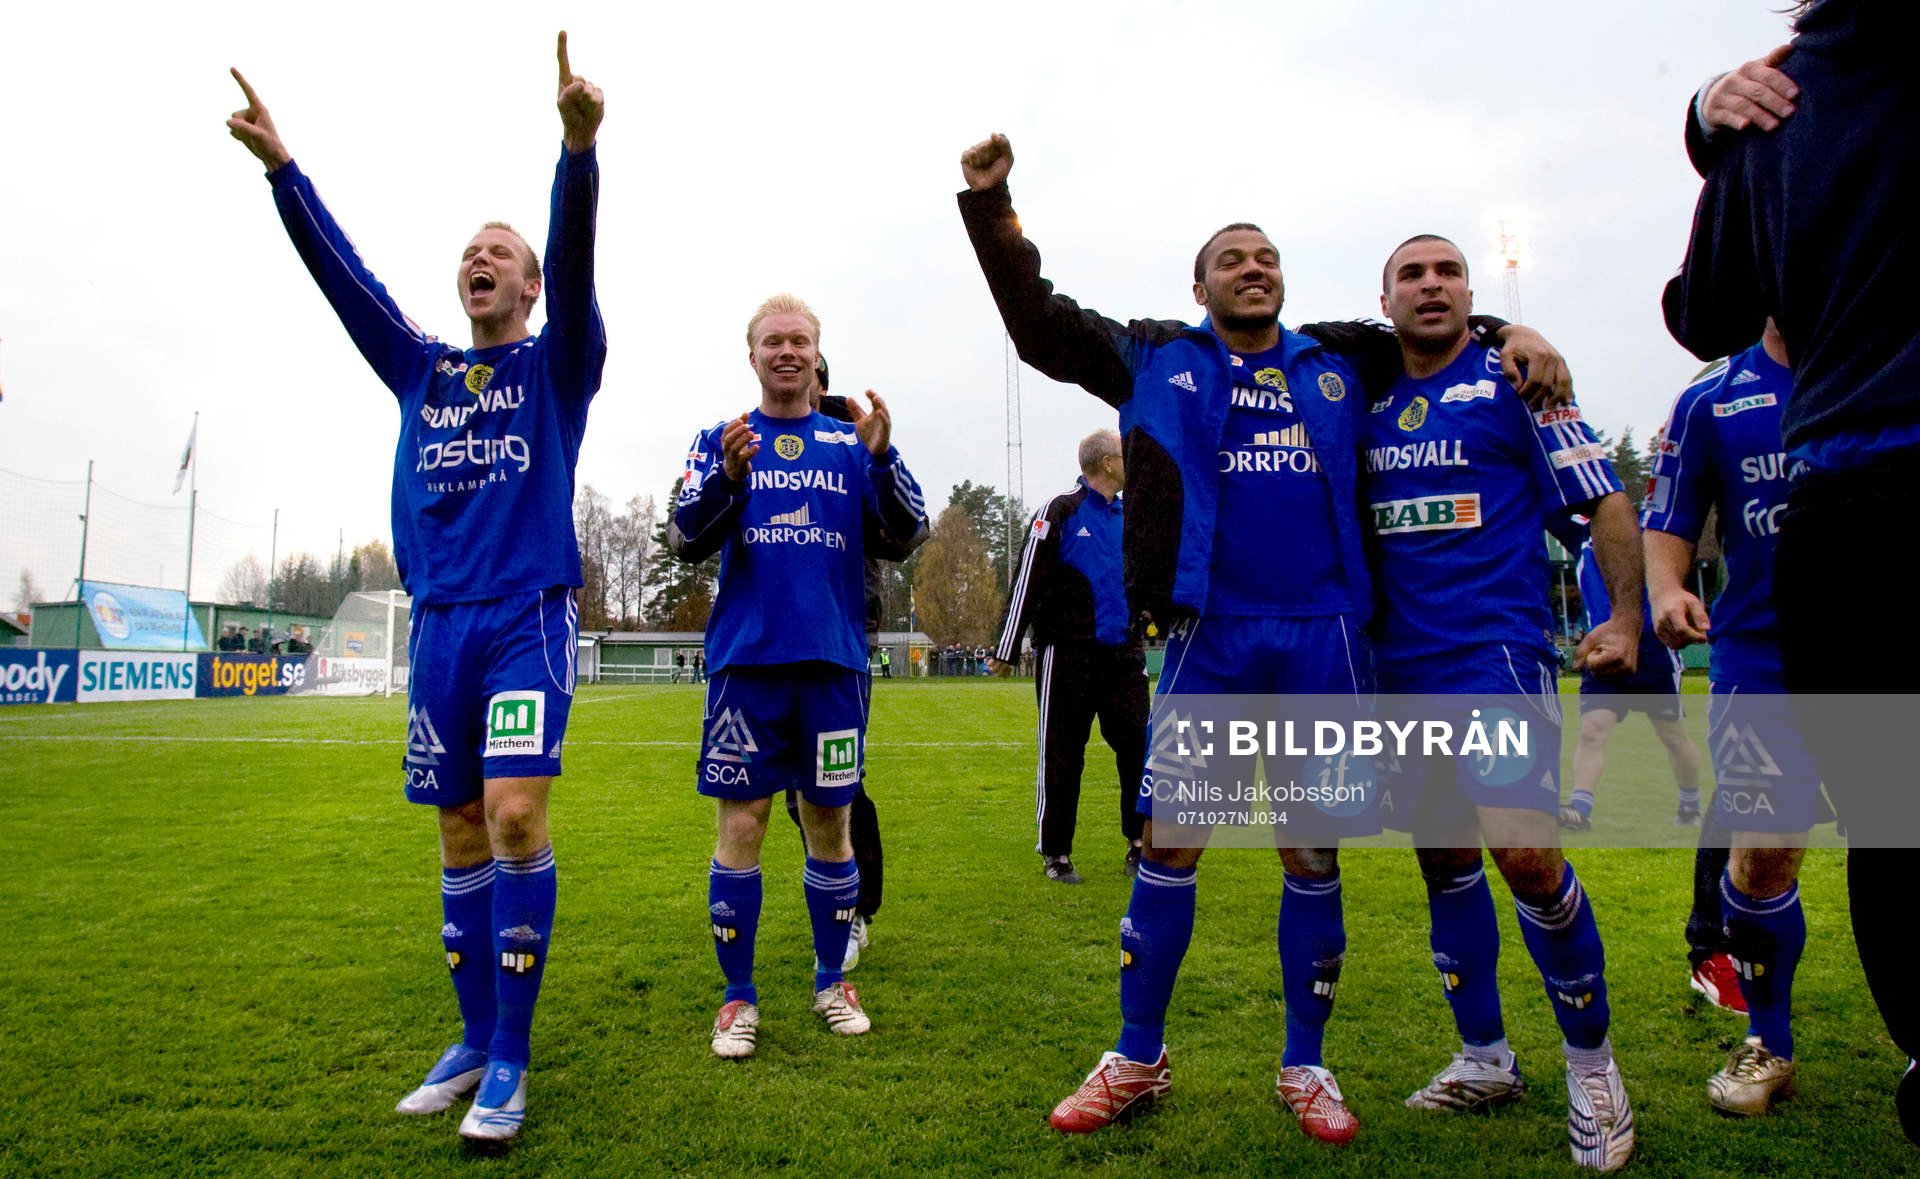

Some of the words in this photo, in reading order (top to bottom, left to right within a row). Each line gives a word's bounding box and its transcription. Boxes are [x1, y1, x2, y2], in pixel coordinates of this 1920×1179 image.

[1722, 397, 1766, 414] PEAB
[416, 429, 531, 473] osting
[1365, 439, 1469, 474] UNDSVALL
[1375, 500, 1456, 530] EAB
[82, 661, 193, 692] SIEMENS
[212, 656, 306, 696] torget.se
[489, 739, 534, 750] Mitthem
[705, 763, 750, 785] SCA
[1140, 774, 1189, 806] SCA
[1720, 789, 1776, 815] SCA
